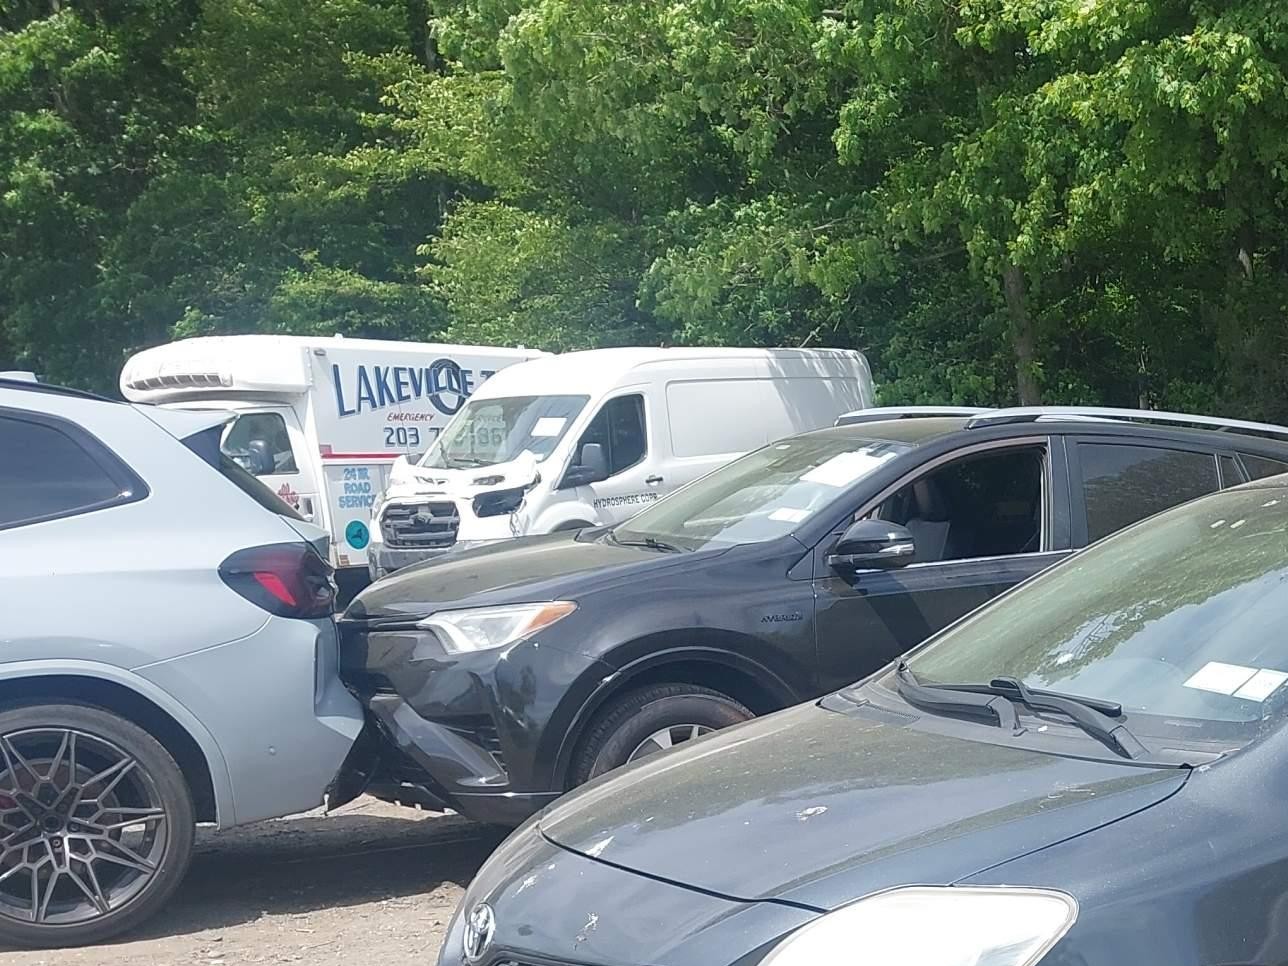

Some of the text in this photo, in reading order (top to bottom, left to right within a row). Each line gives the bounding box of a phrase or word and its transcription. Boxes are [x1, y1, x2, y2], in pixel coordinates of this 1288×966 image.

[332, 363, 474, 417] LAKEVILLE
[386, 412, 434, 422] EMERGENCY
[384, 427, 420, 446] 203
[344, 481, 371, 494] ROAD
